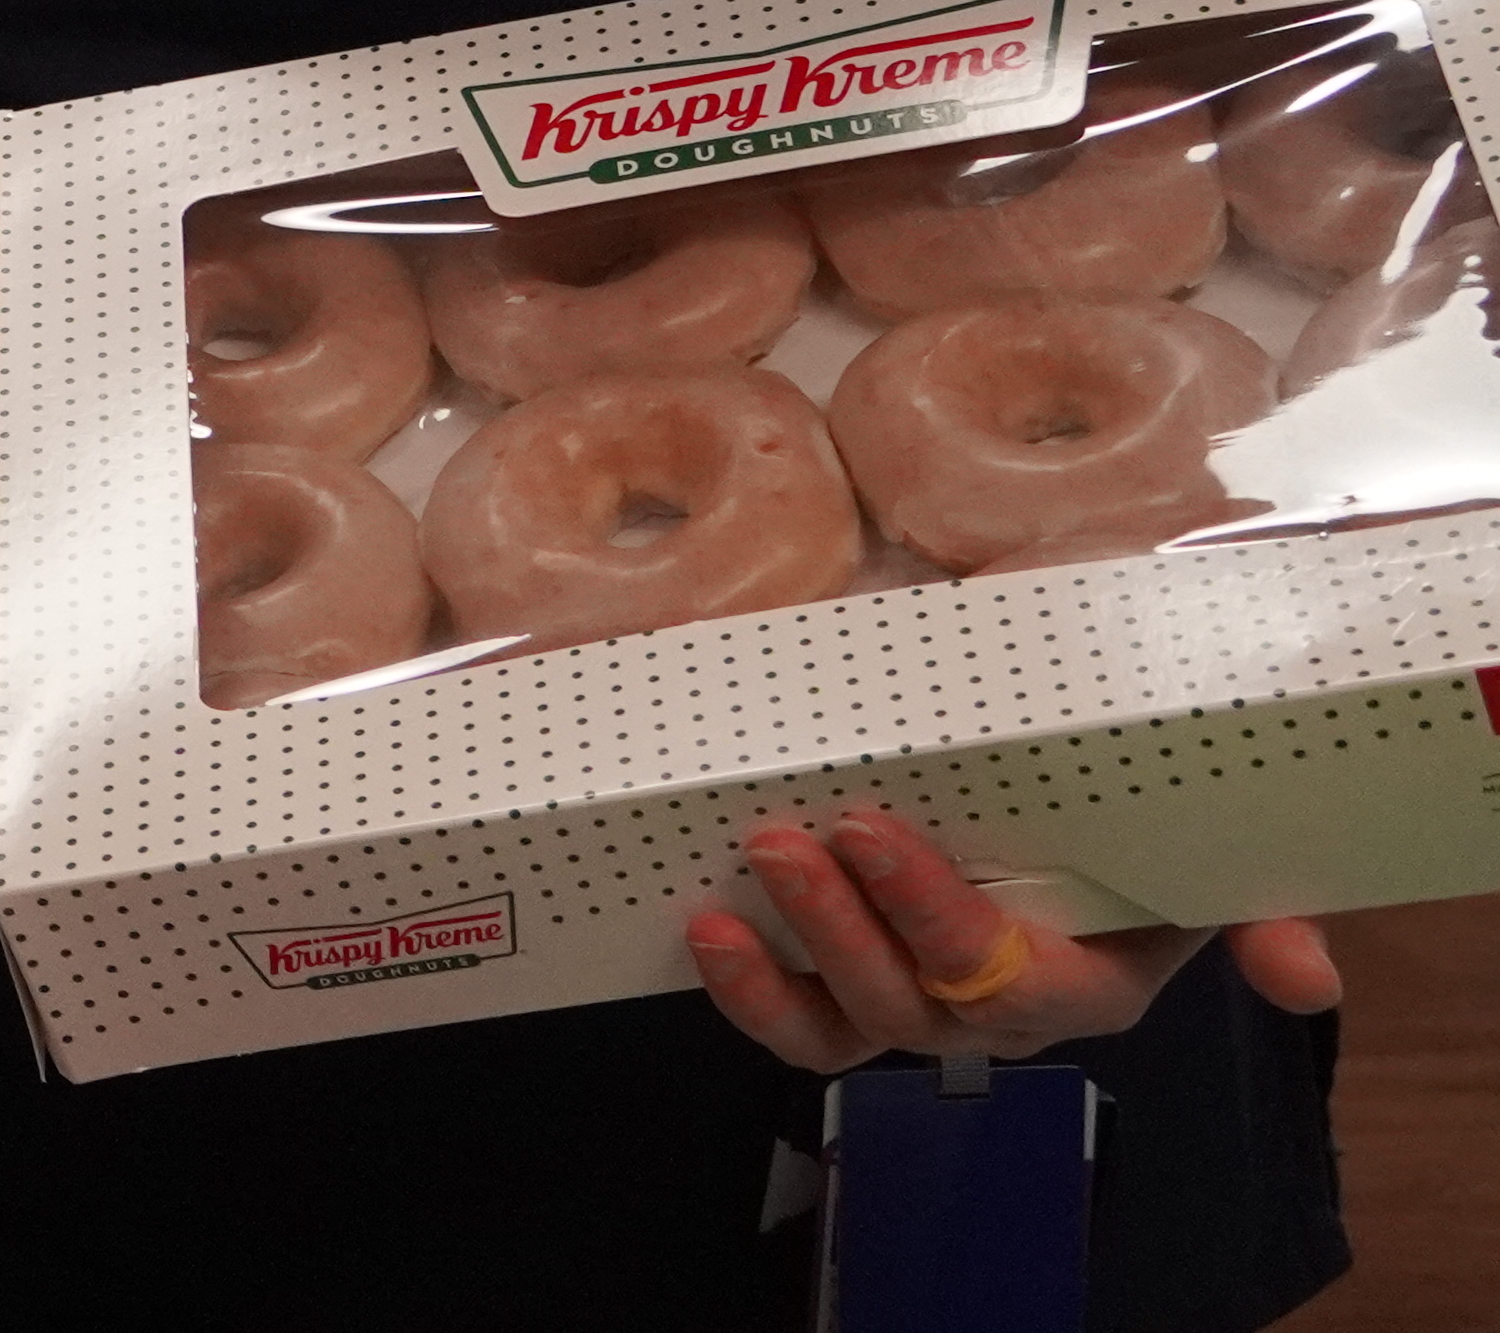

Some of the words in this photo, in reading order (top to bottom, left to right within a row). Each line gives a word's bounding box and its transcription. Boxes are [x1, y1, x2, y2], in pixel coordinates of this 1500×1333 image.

[521, 60, 777, 162] Krispy
[777, 15, 1036, 114] Kreme
[615, 105, 940, 178] DOUGHNUTS
[266, 928, 384, 976] Krispy
[384, 910, 504, 958] Kreme
[319, 957, 470, 988] DOUGHNUTS
